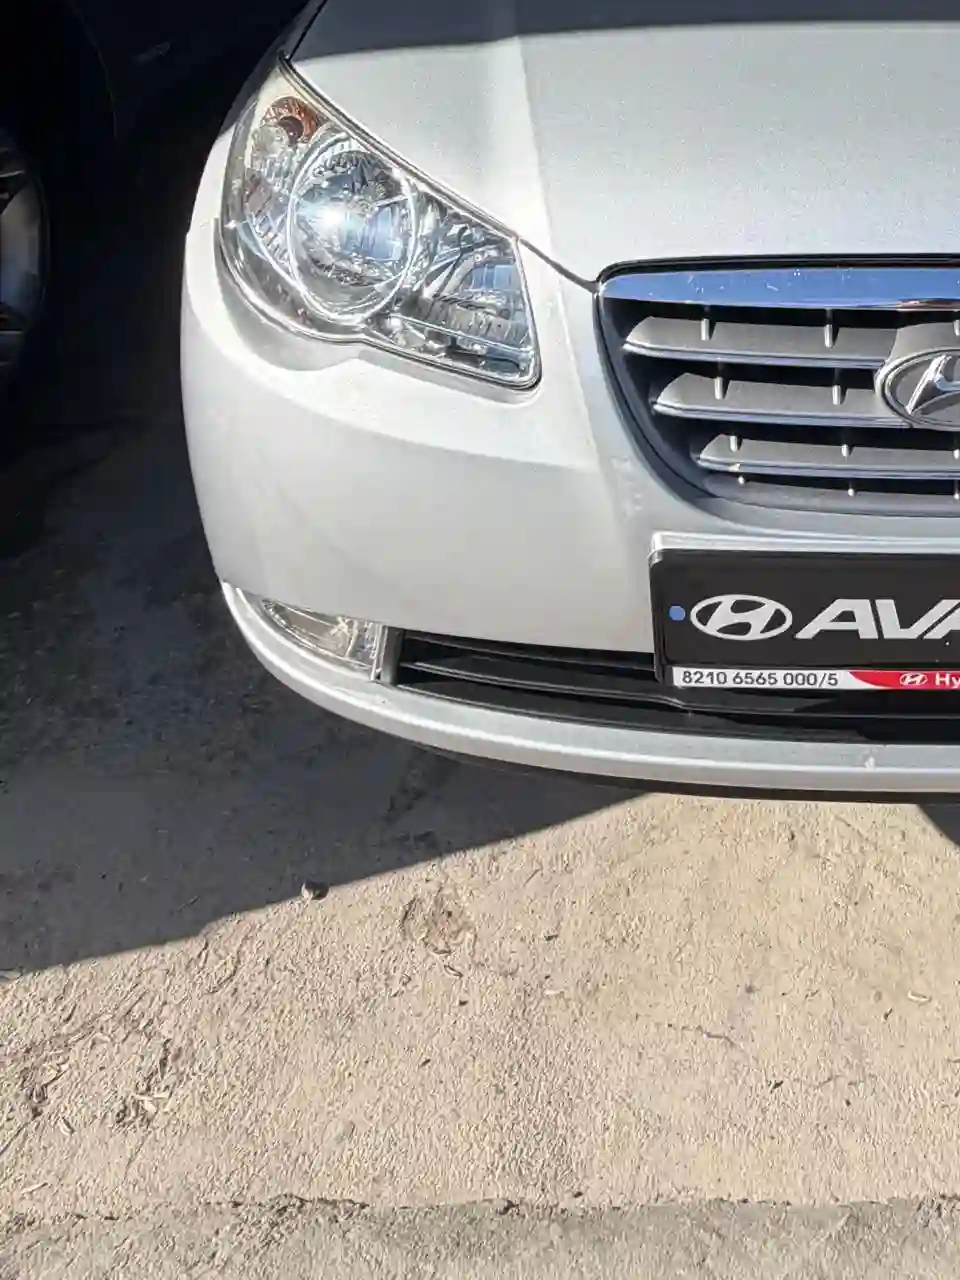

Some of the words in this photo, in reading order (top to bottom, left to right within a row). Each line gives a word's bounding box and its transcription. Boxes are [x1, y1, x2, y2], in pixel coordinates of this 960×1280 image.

[682, 671, 728, 685] 8210
[732, 671, 778, 686] 6565
[783, 673, 839, 688] 000/5
